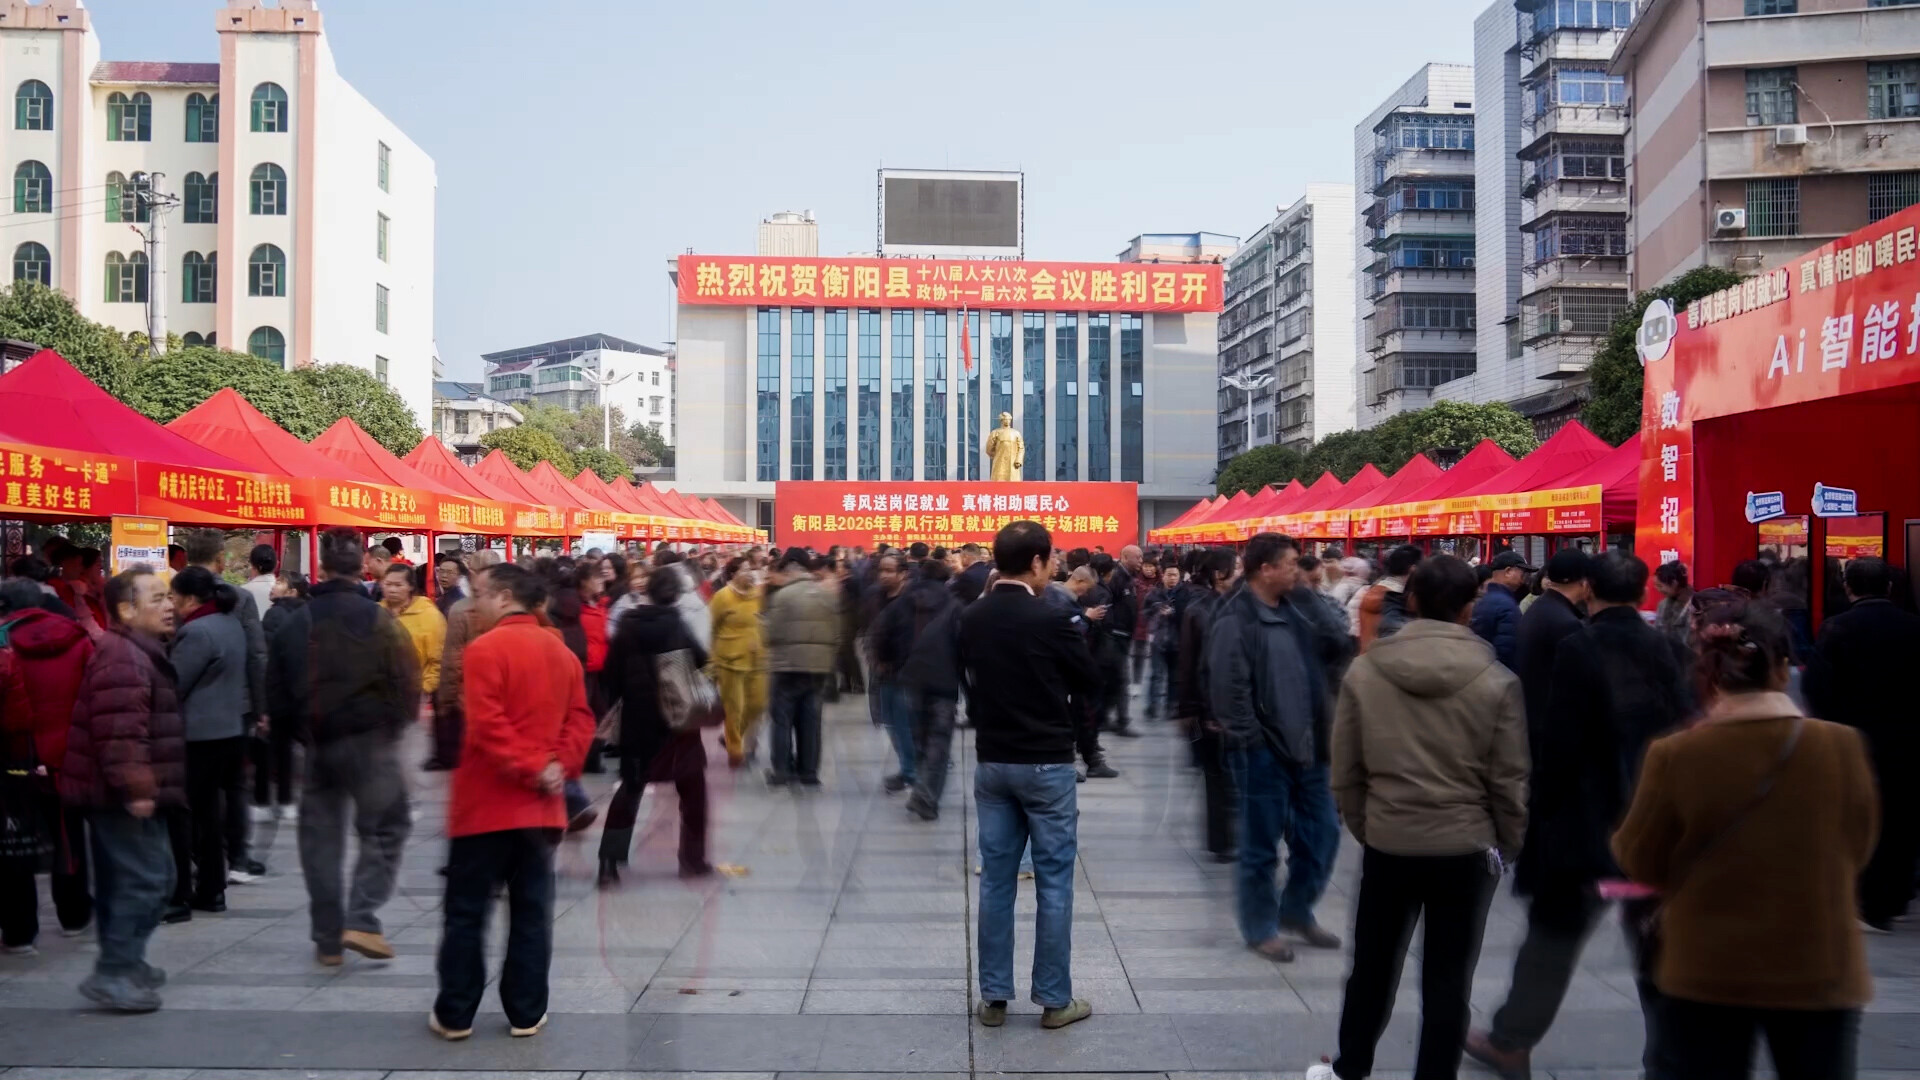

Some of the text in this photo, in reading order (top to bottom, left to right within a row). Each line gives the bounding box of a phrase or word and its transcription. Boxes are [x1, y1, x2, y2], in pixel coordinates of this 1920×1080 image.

[697, 262, 911, 298] 热烈祝贺衡阳县
[916, 264, 1027, 282] 十八届人大八次
[1030, 268, 1208, 304] 会议胜利召开
[1687, 226, 1920, 329] 春风送岗促就业 真情相助暖民
[916, 284, 1027, 302] 政协十一届六次
[1768, 328, 1806, 379] Ai
[6, 481, 91, 509] 惠美好生活
[842, 493, 1070, 512] 春风送岗促就业 真情相助暖民心
